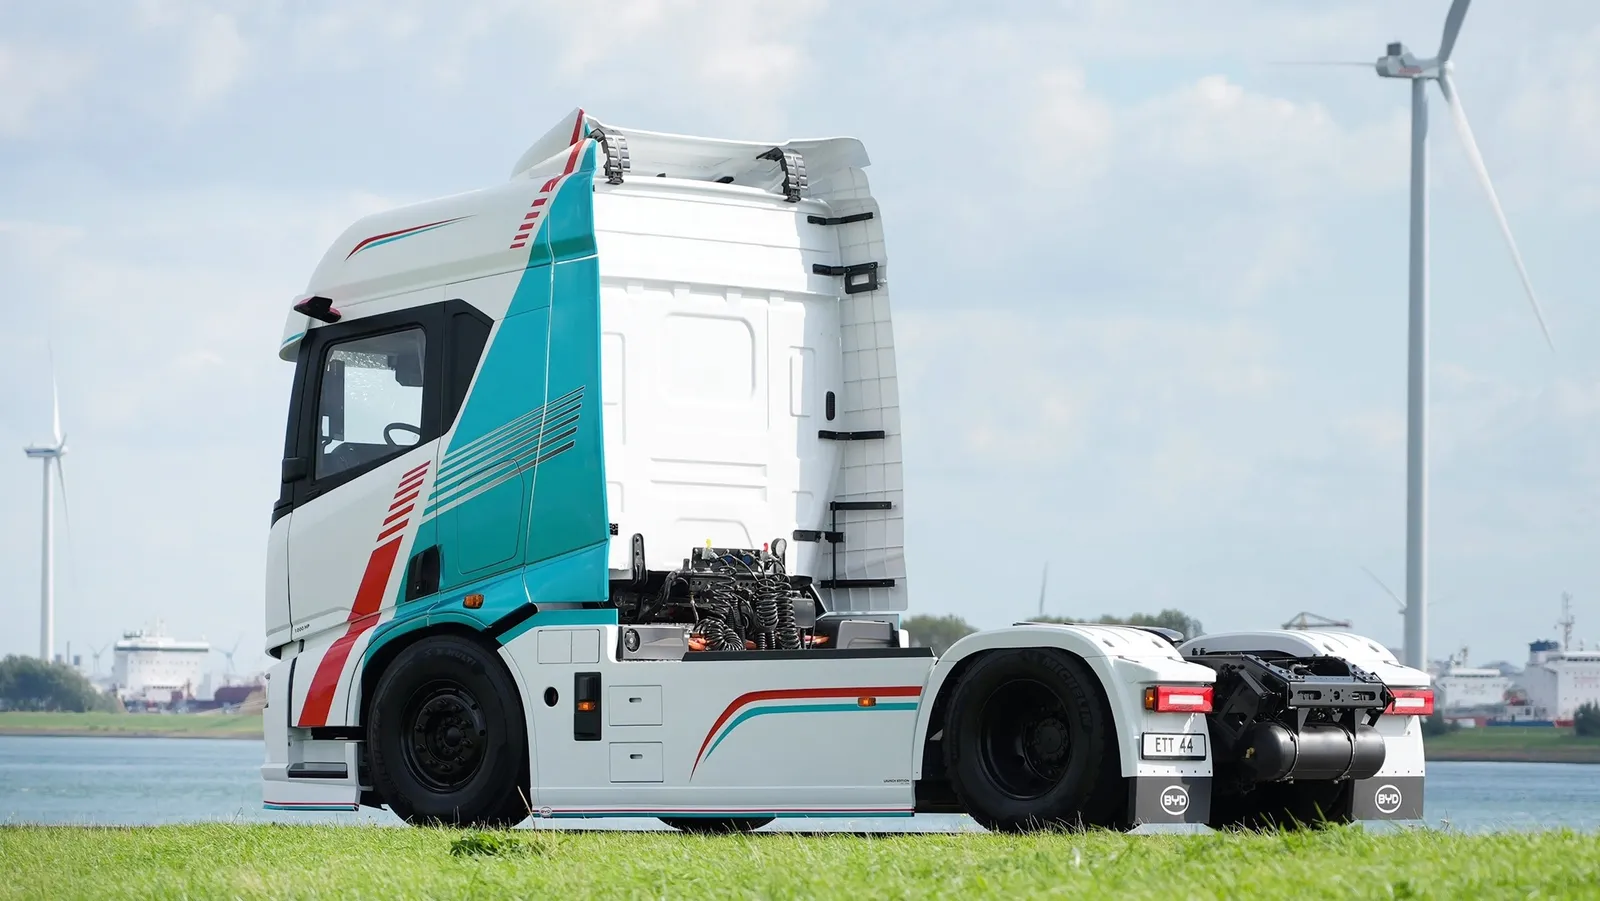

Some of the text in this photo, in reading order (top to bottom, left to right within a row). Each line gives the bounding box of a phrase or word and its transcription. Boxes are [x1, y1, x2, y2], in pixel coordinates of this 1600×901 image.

[1042, 656, 1093, 728] MICHELIN
[1155, 737, 1194, 753] ETT 44
[1163, 794, 1187, 806] BYD
[1378, 793, 1399, 804] BYD
